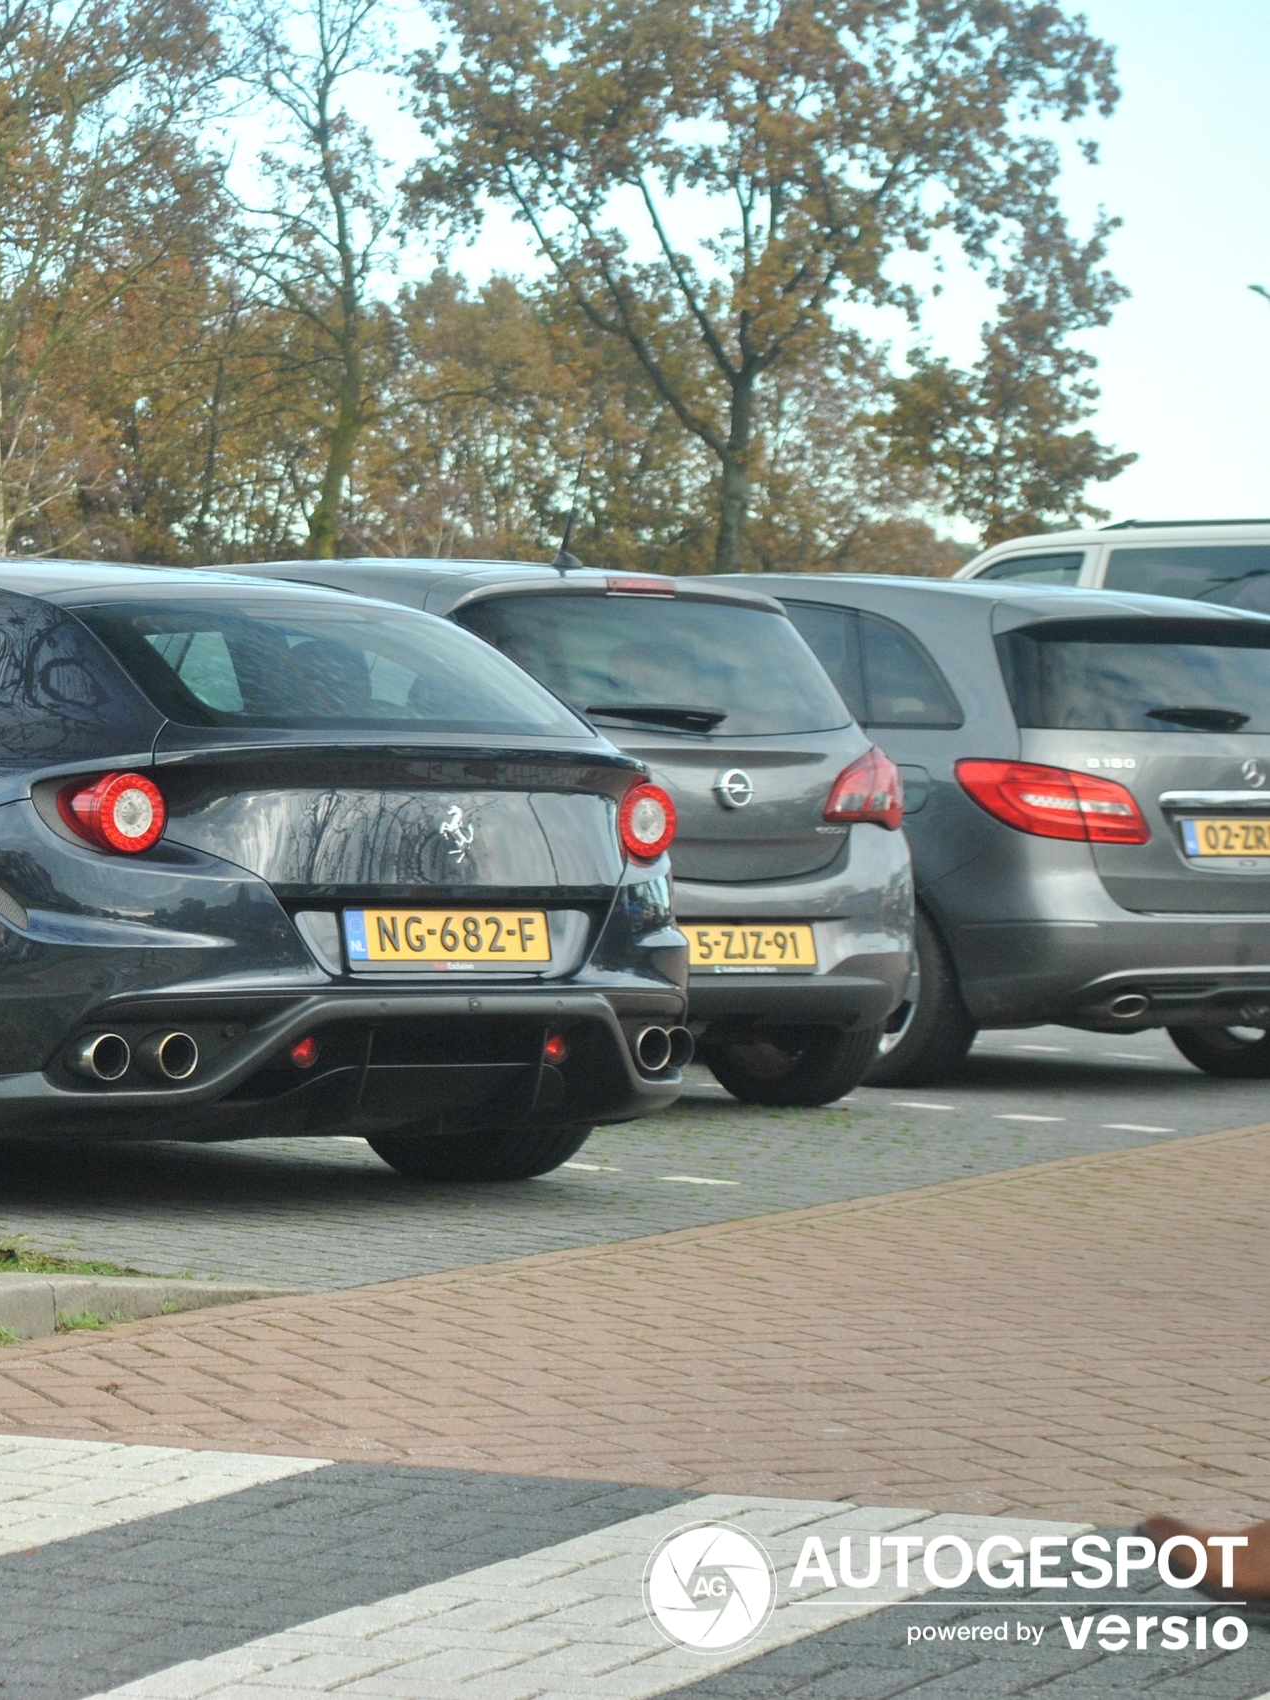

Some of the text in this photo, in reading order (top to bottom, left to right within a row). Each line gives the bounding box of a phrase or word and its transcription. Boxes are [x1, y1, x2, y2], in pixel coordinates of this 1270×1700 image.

[1205, 825, 1270, 850] 02-ZR
[350, 940, 366, 952] NL
[376, 915, 536, 953] NG-682-F
[696, 930, 800, 960] 5-ZJZ-91
